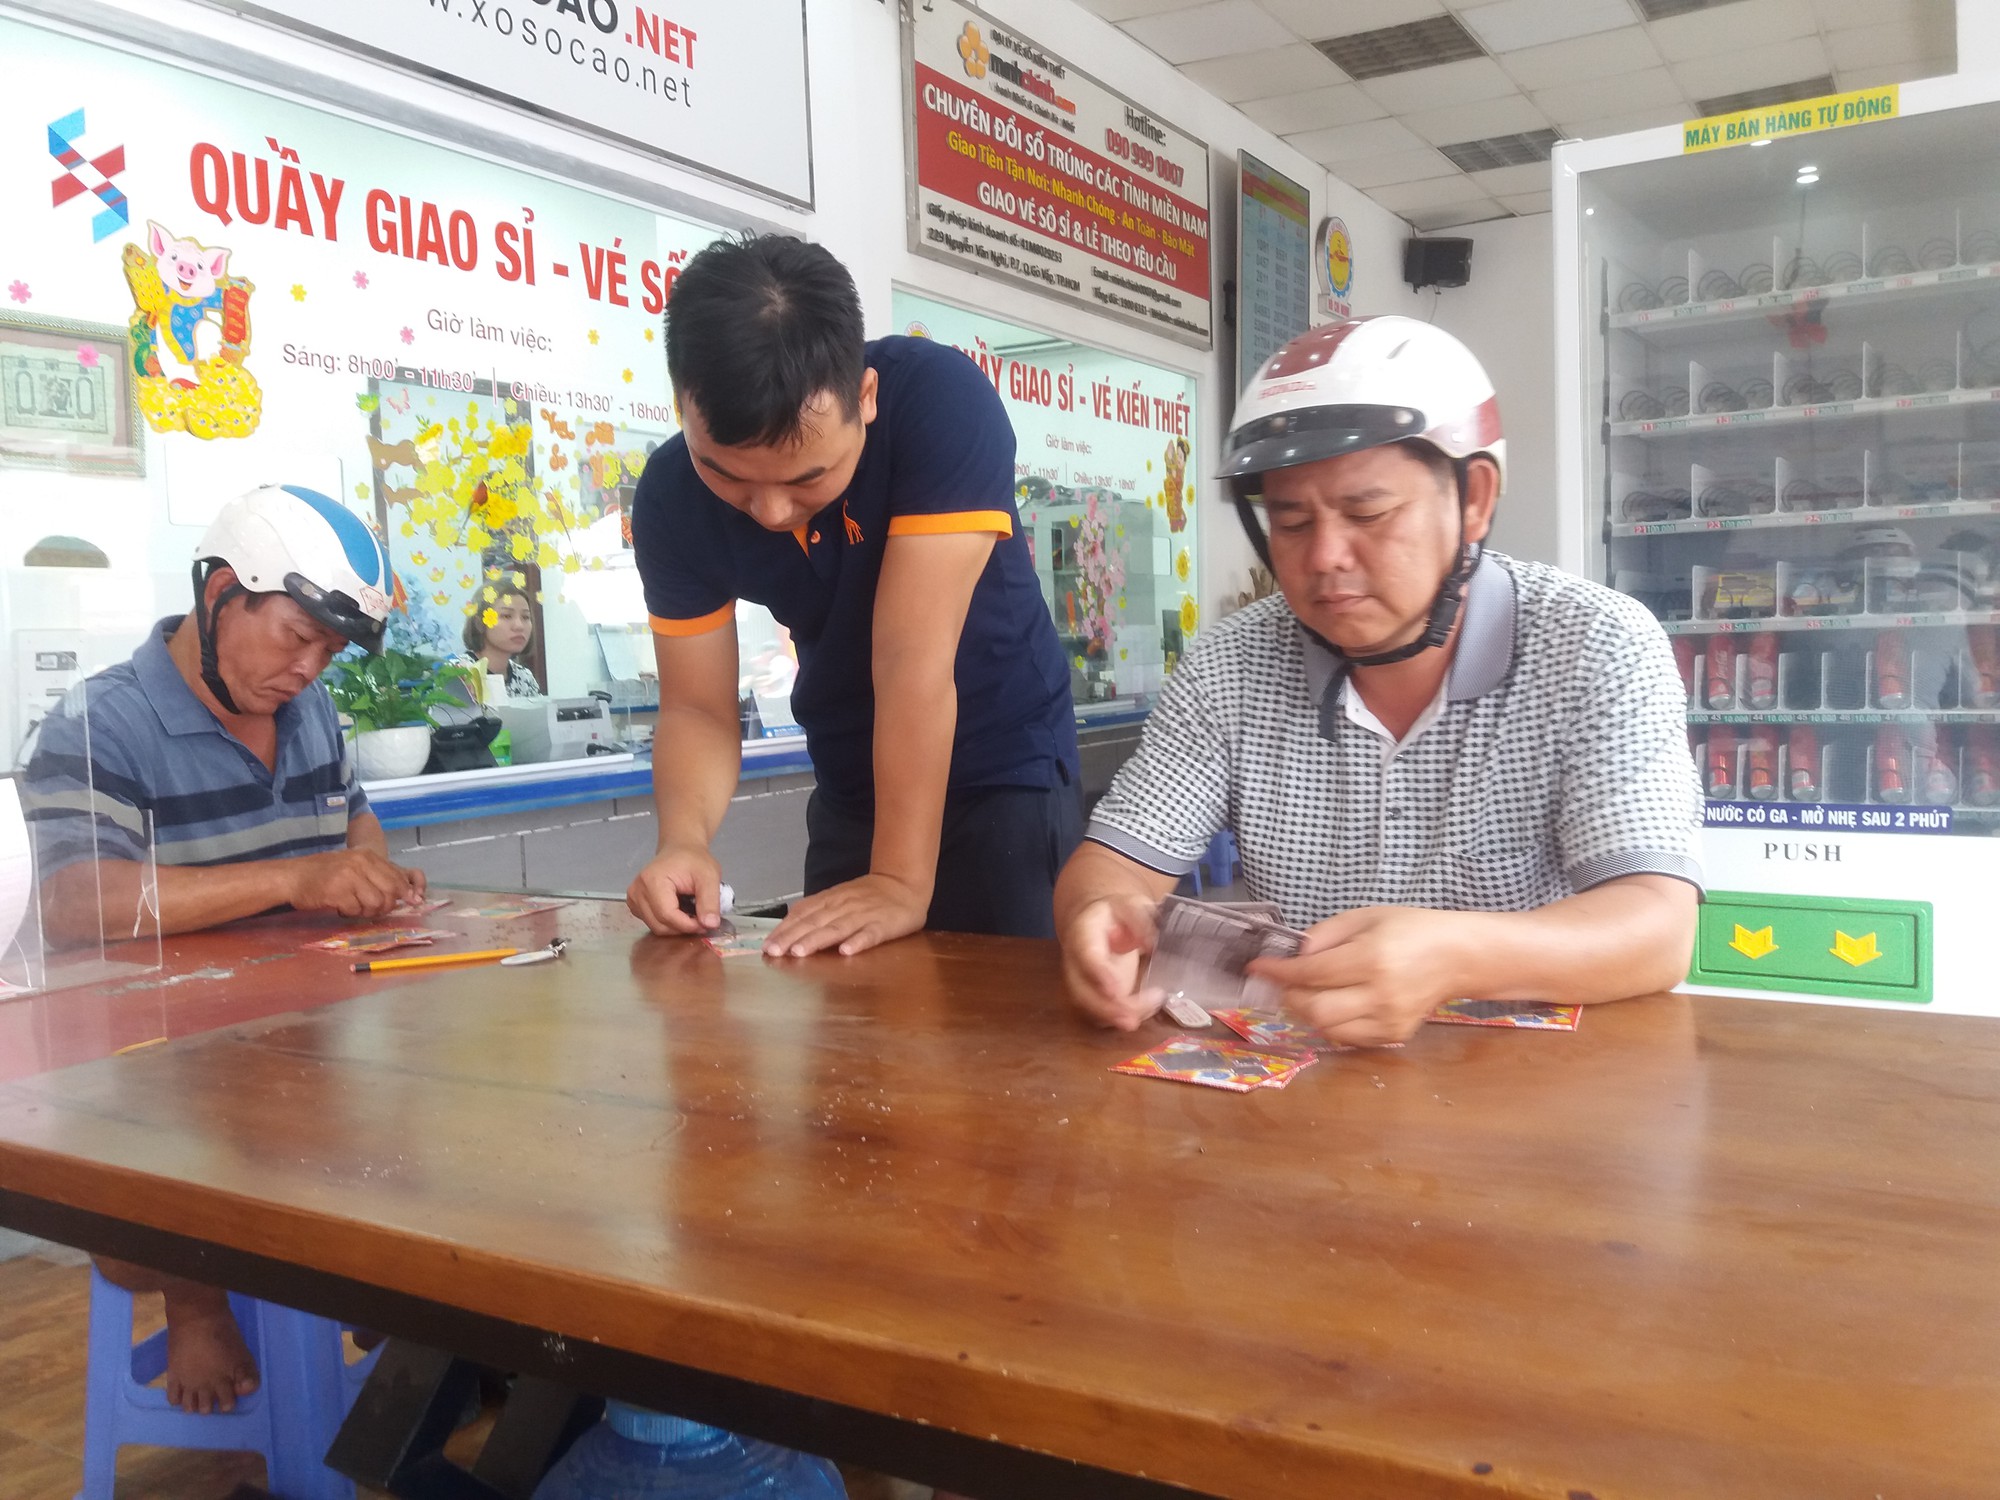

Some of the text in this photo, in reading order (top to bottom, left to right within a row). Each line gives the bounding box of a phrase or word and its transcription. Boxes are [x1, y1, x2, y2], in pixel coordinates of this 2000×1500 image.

[1124, 105, 1166, 147] Hotline:
[1686, 96, 1892, 147] MÁY BÁN HÀNG TỰ ĐỘNG
[924, 83, 1207, 239] CHUYÊN ĐỔI SỐ TRÚNG CÁC TỈNH MIỀN NAM
[1105, 128, 1184, 188] 090 999 0007
[947, 131, 976, 159] Giao
[978, 143, 1004, 172] Tiền
[1006, 156, 1025, 182] Tận
[1027, 167, 1050, 193] Nơi:
[1052, 178, 1085, 208] Nhanh
[1086, 194, 1116, 226] Chóng
[1122, 212, 1134, 231] An
[1137, 217, 1156, 239] Toàn
[189, 136, 345, 242] QUẦY
[366, 189, 477, 272] GIAO
[494, 206, 536, 286] SỈ
[553, 262, 569, 277] -
[579, 238, 629, 306] VÉ
[978, 181, 1015, 215] GIAO
[1017, 197, 1036, 224] VÉ
[1058, 210, 1070, 239] SỈ
[1073, 221, 1083, 243] &
[1085, 221, 1099, 251] LẺ
[1101, 232, 1131, 263] THEO
[1133, 245, 1153, 272] YÊU
[1156, 252, 1177, 281] CẦU
[427, 309, 552, 352] Giờ làm việc:
[283, 344, 341, 372] Sáng:
[511, 378, 562, 406] Chiều:
[1010, 359, 1051, 407] GIAO
[1057, 363, 1074, 413] SỈ
[1080, 396, 1086, 405] -
[1092, 376, 1112, 421] VÉ
[1116, 380, 1150, 429] KIẾN
[1153, 389, 1191, 437] THIẾT
[1707, 521, 1720, 529] 23
[1720, 623, 1732, 631] 33
[1706, 804, 1743, 823] NƯỚC
[1747, 805, 1766, 824] CÓ
[1769, 809, 1788, 824] GA
[1801, 805, 1825, 825] MỞ
[1828, 811, 1857, 828] NHẸ
[1862, 811, 1891, 827] SAU
[1895, 812, 1905, 827] 2
[1909, 809, 1950, 828] PHÚT
[1763, 842, 1842, 862] PUSH
